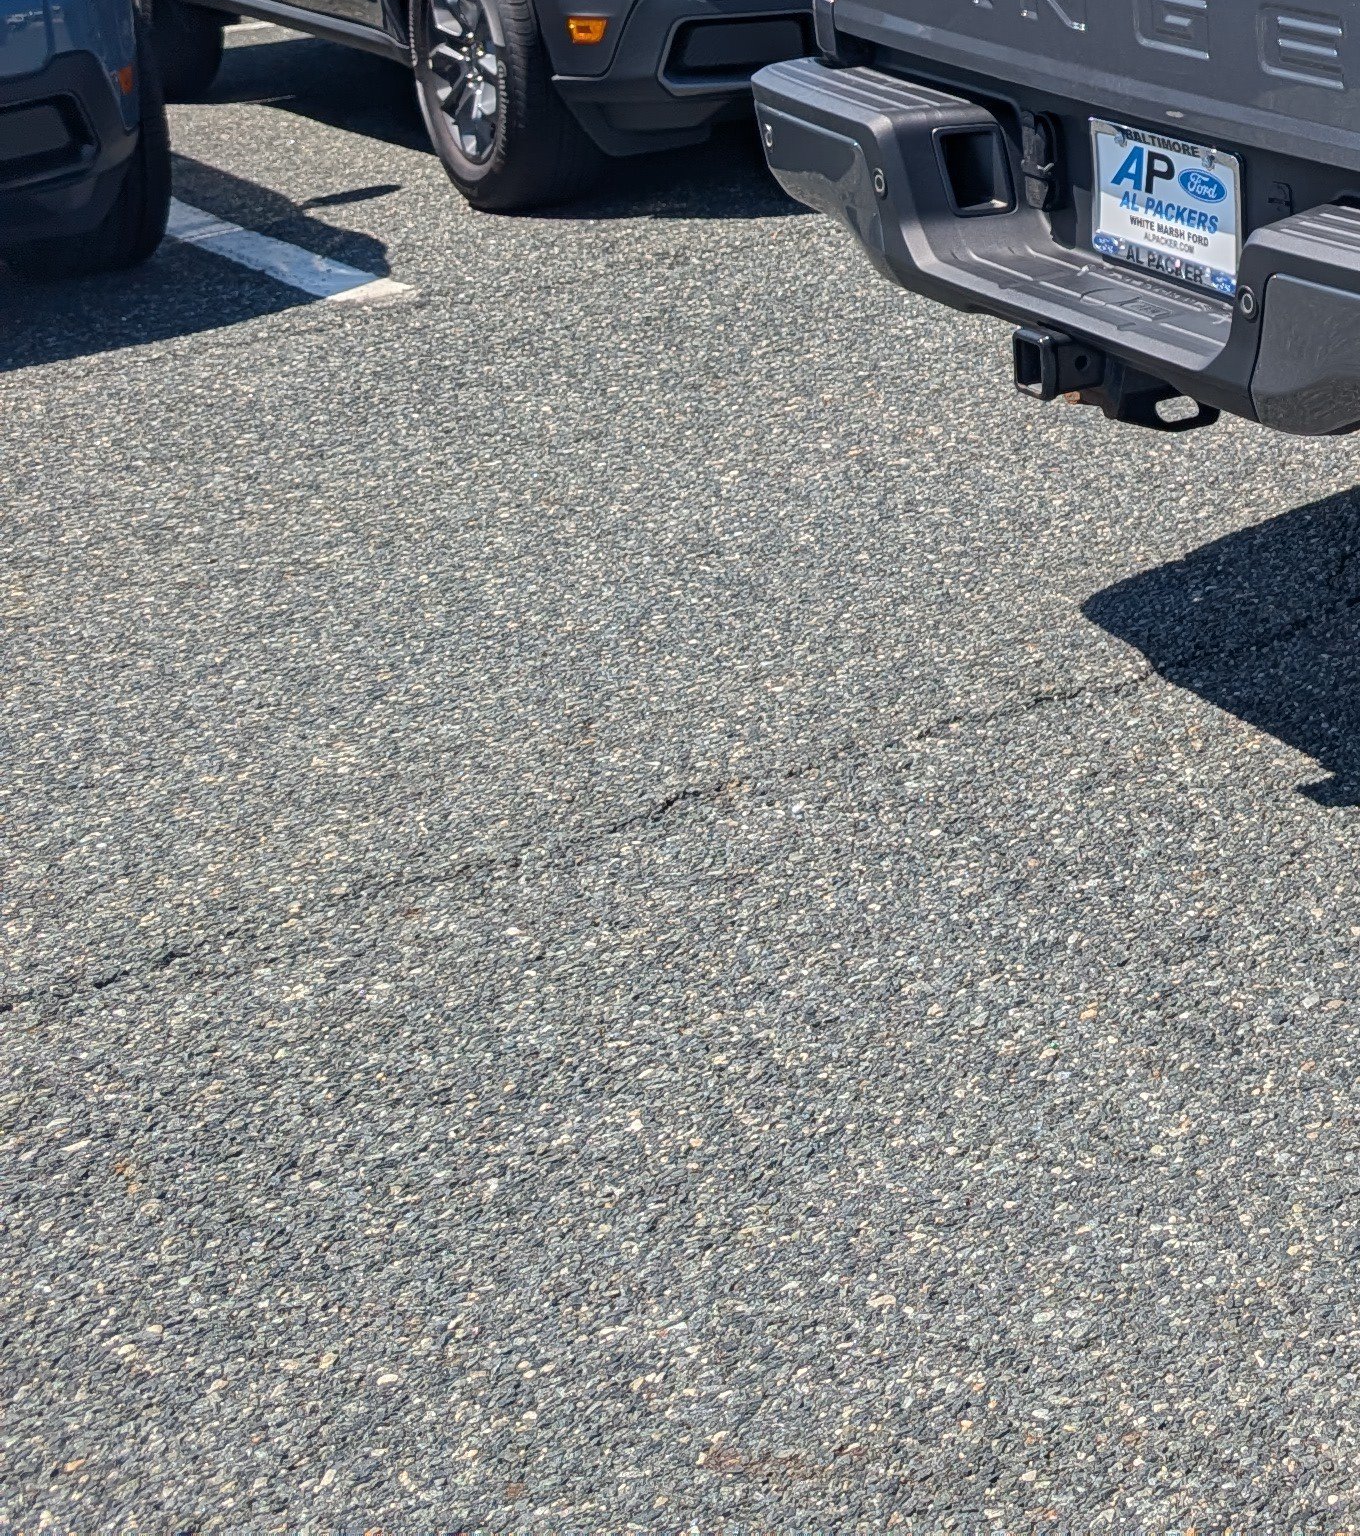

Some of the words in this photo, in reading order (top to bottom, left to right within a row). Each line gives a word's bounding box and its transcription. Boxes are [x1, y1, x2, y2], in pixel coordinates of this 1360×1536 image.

[1125, 129, 1200, 157] BALTIMORE
[1111, 145, 1175, 194] AP
[1185, 170, 1221, 201] Ford
[1120, 190, 1139, 211] AL
[1145, 197, 1219, 234] PACKERS
[1129, 215, 1155, 232] WHITE
[1157, 222, 1185, 239] MARSH
[1187, 231, 1209, 247] FORD
[1143, 232, 1195, 254] ALPACKER.COM
[1126, 244, 1144, 264] AL
[1147, 253, 1203, 283] PACKER
